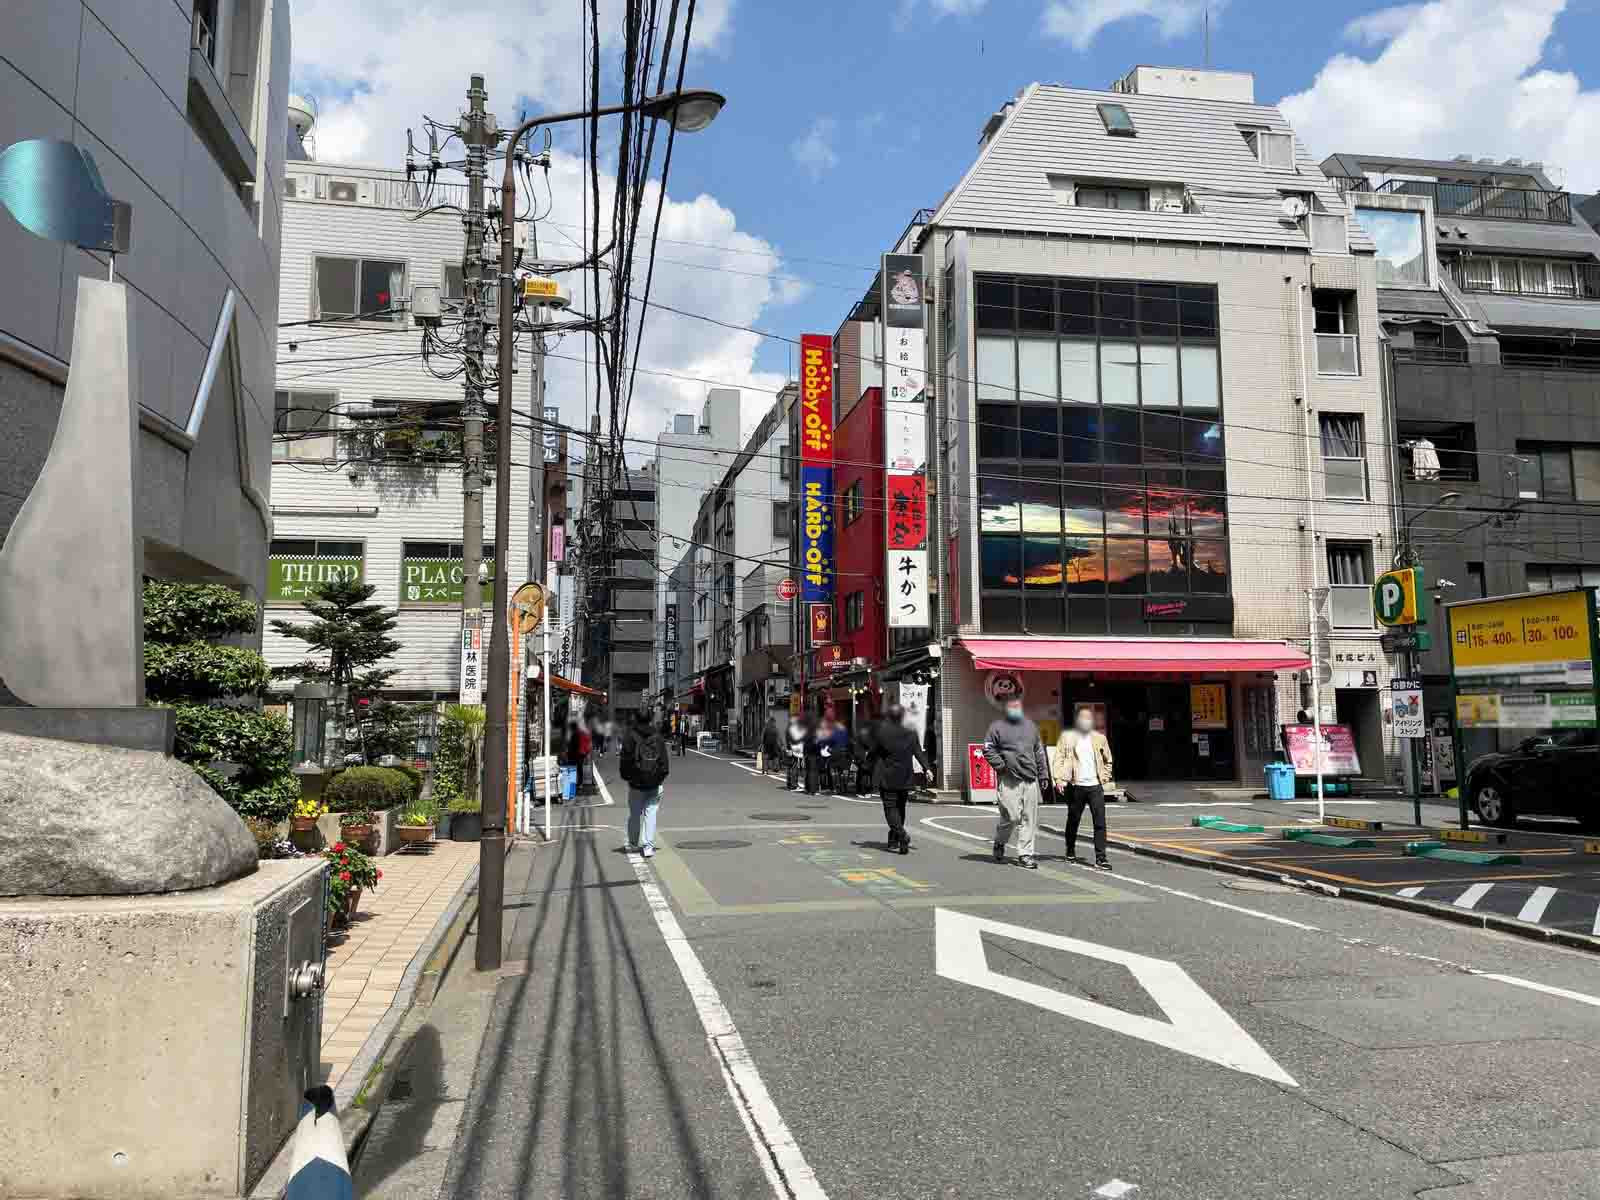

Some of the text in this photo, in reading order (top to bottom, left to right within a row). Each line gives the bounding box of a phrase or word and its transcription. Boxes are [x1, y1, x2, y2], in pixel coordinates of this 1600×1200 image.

[544, 408, 557, 459] 中ビル
[281, 563, 464, 584] THIRD PLAC
[898, 555, 918, 616] 牛かつ
[423, 586, 464, 598] スペー
[1381, 583, 1400, 617] P
[1490, 632, 1515, 646] 400
[1528, 629, 1547, 643] 30
[464, 650, 478, 690] 林医院
[1395, 719, 1423, 727] アイドリング
